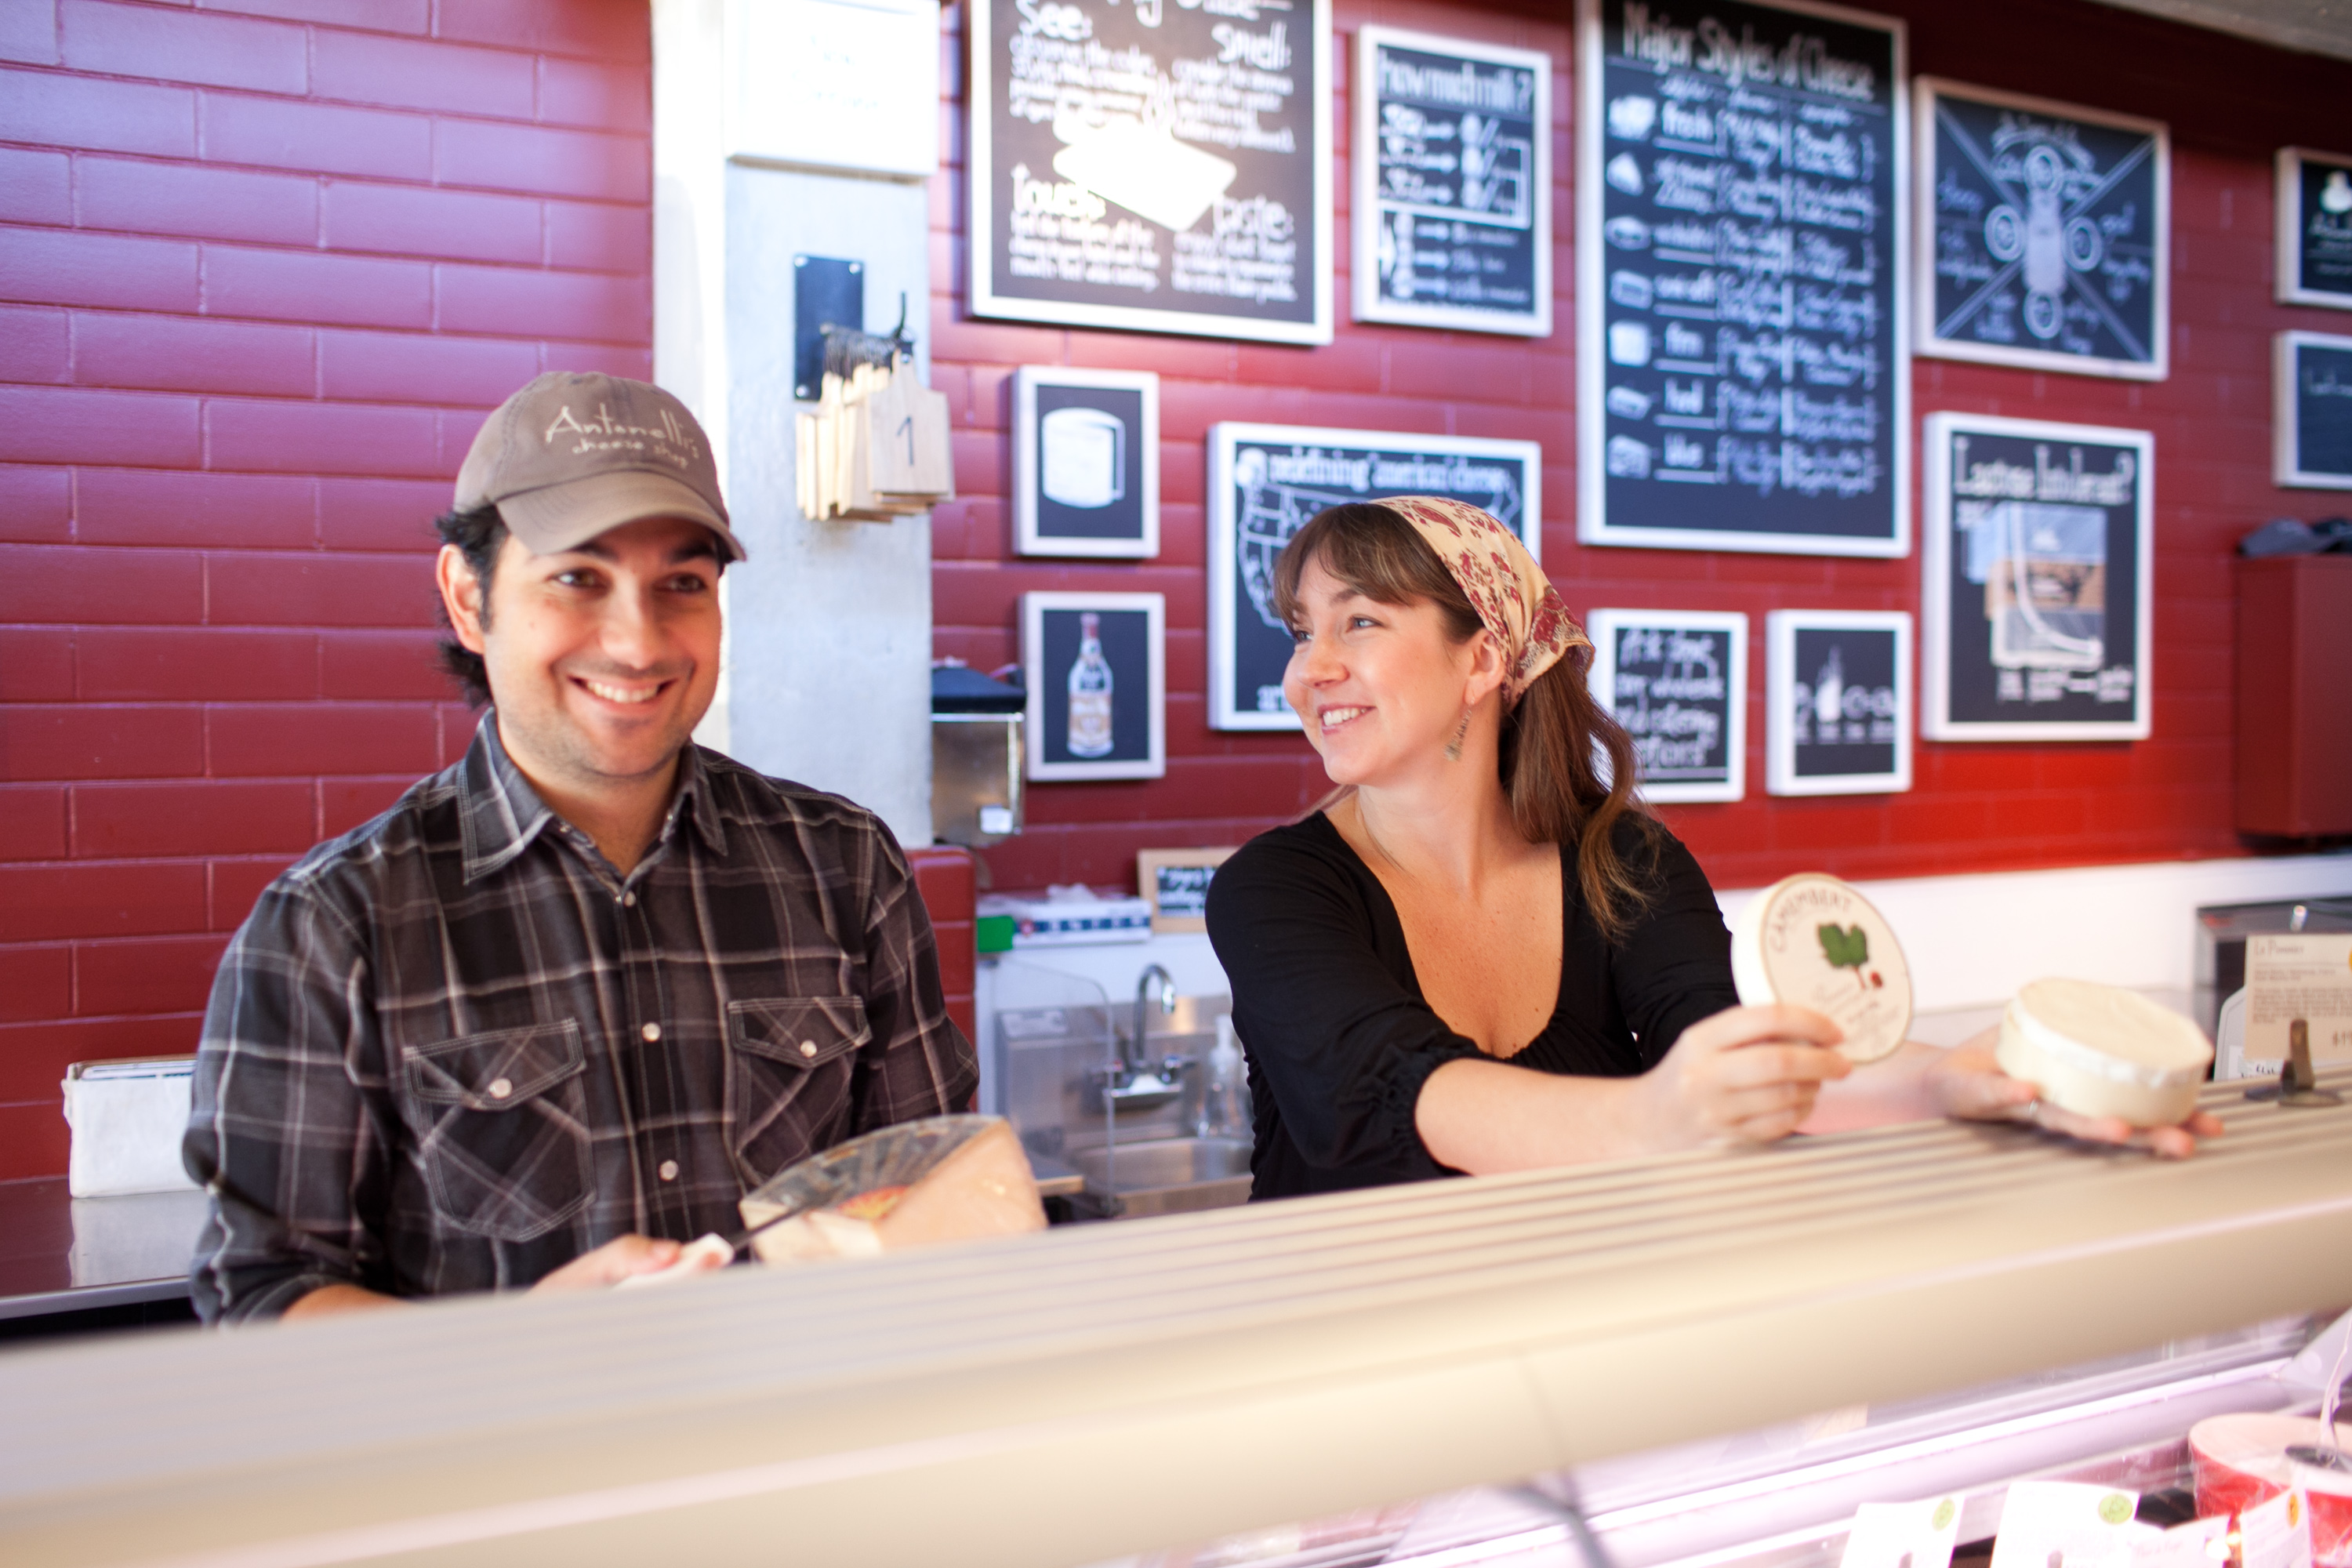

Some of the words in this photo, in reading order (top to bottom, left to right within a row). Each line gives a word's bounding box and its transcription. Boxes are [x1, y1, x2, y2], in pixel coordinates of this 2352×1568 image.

[1622, 2, 1696, 74] Major
[1697, 18, 1775, 86] Styles
[1778, 34, 1802, 86] of
[1805, 38, 1875, 101] Cheese
[896, 415, 914, 466] 1
